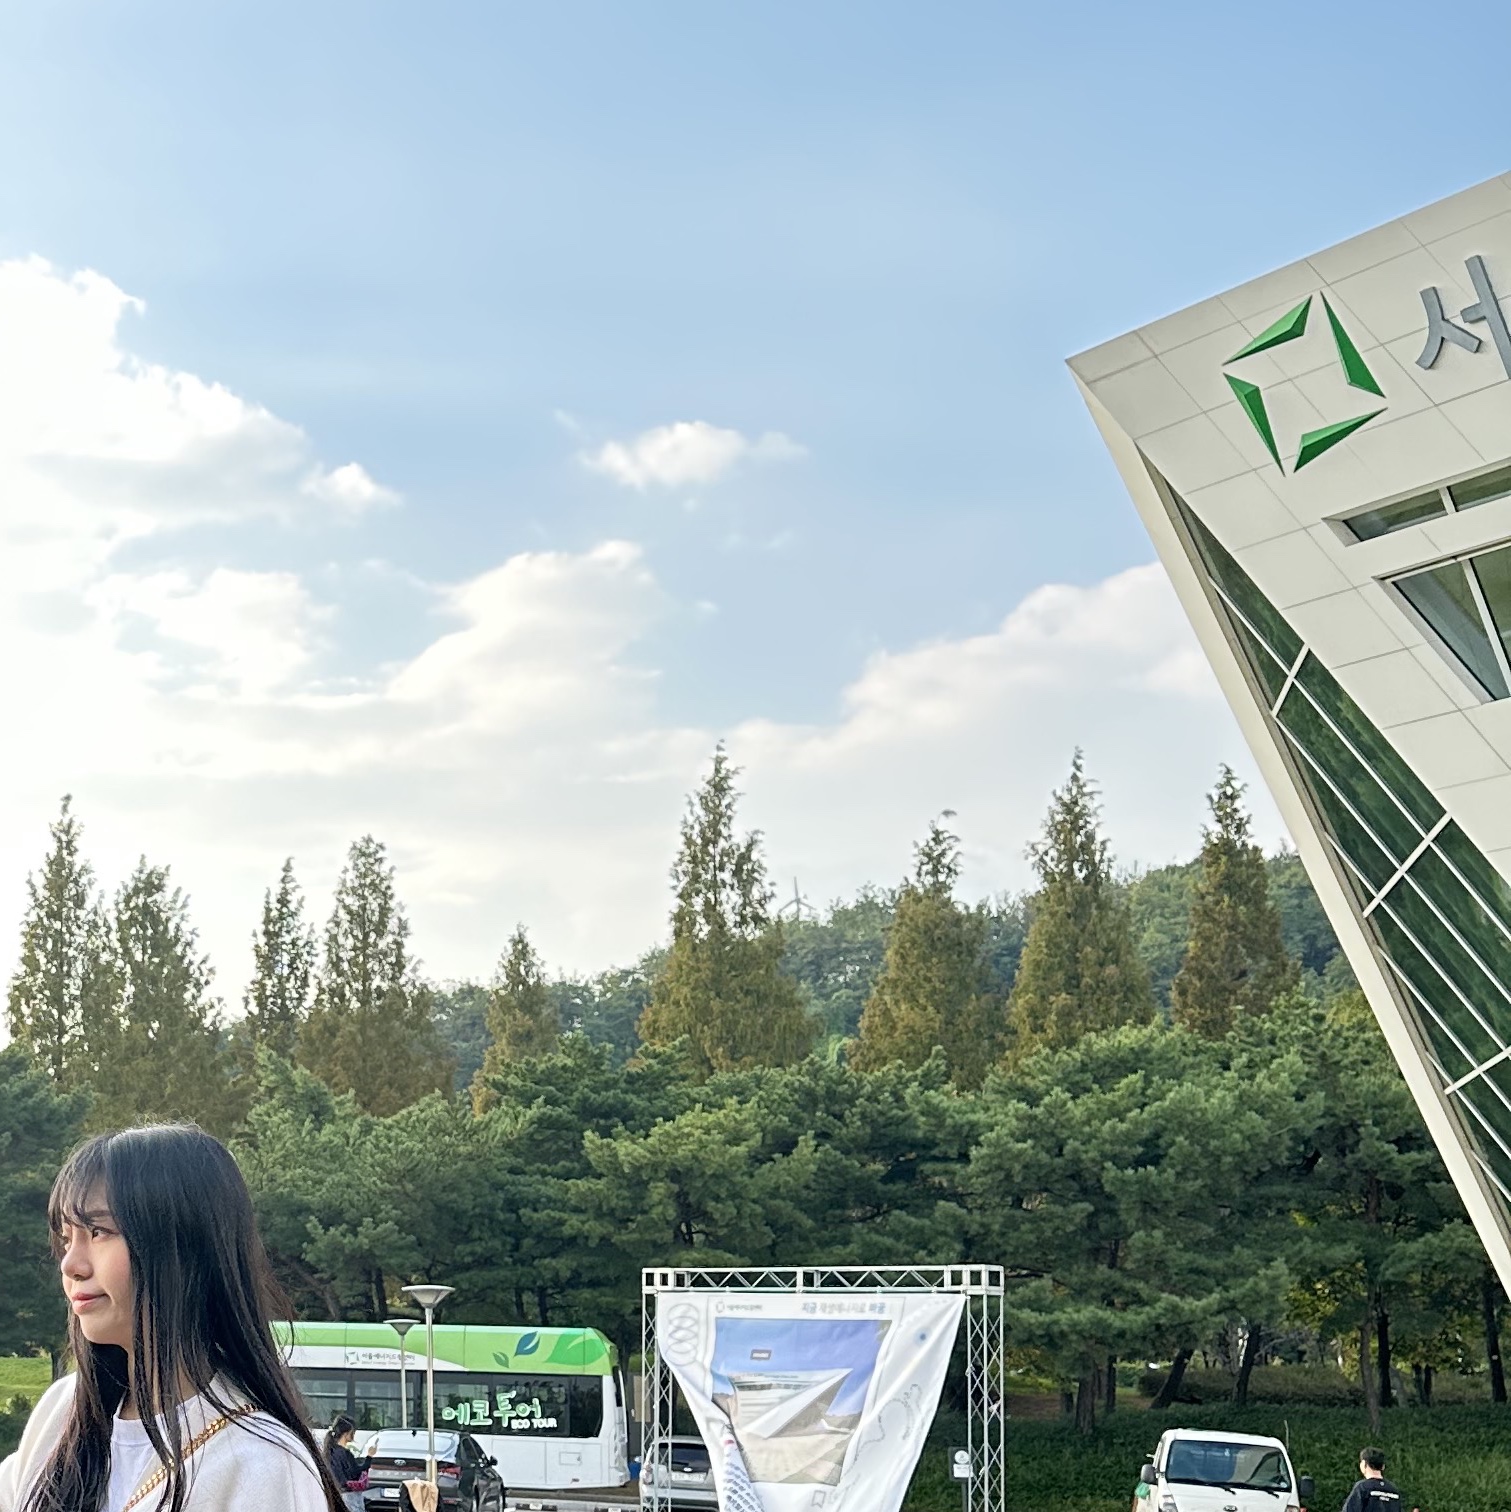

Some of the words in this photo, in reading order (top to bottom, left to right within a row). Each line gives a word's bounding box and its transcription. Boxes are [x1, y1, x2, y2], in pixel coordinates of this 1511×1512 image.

[1415, 255, 1511, 380] 서
[442, 1390, 541, 1427] 에코투어
[511, 1419, 530, 1429] ECO
[532, 1418, 557, 1428] TOUR
